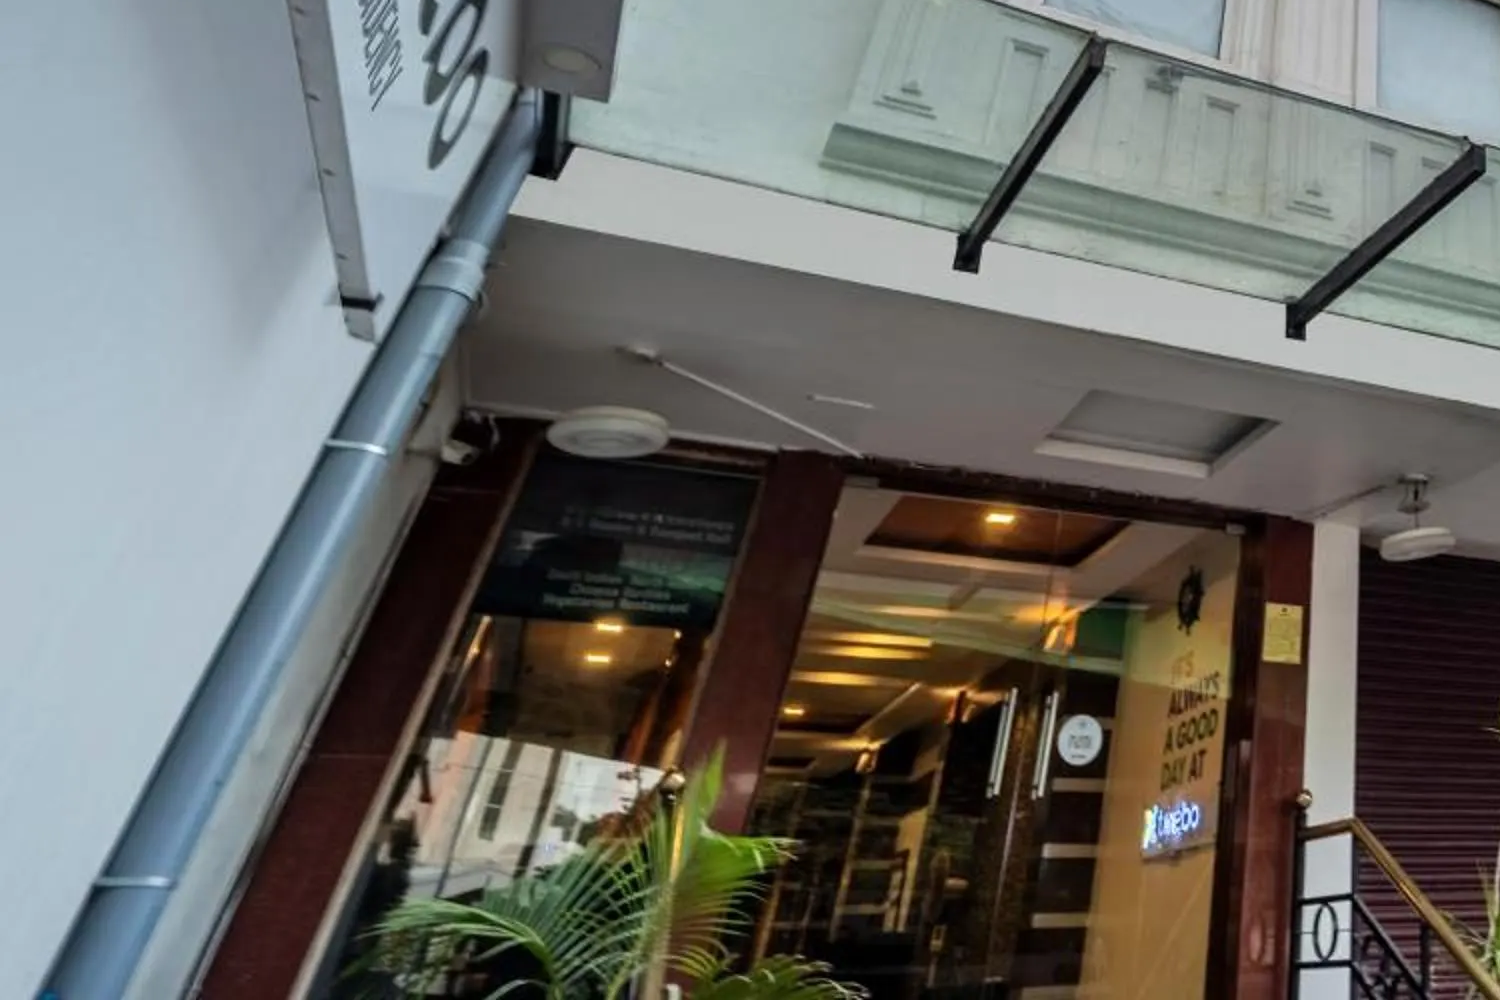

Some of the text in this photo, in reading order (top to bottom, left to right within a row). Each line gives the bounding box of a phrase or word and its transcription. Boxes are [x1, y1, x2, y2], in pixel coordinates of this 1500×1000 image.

[1164, 709, 1219, 753] A GOOD
[1161, 750, 1207, 789] DAY AT
